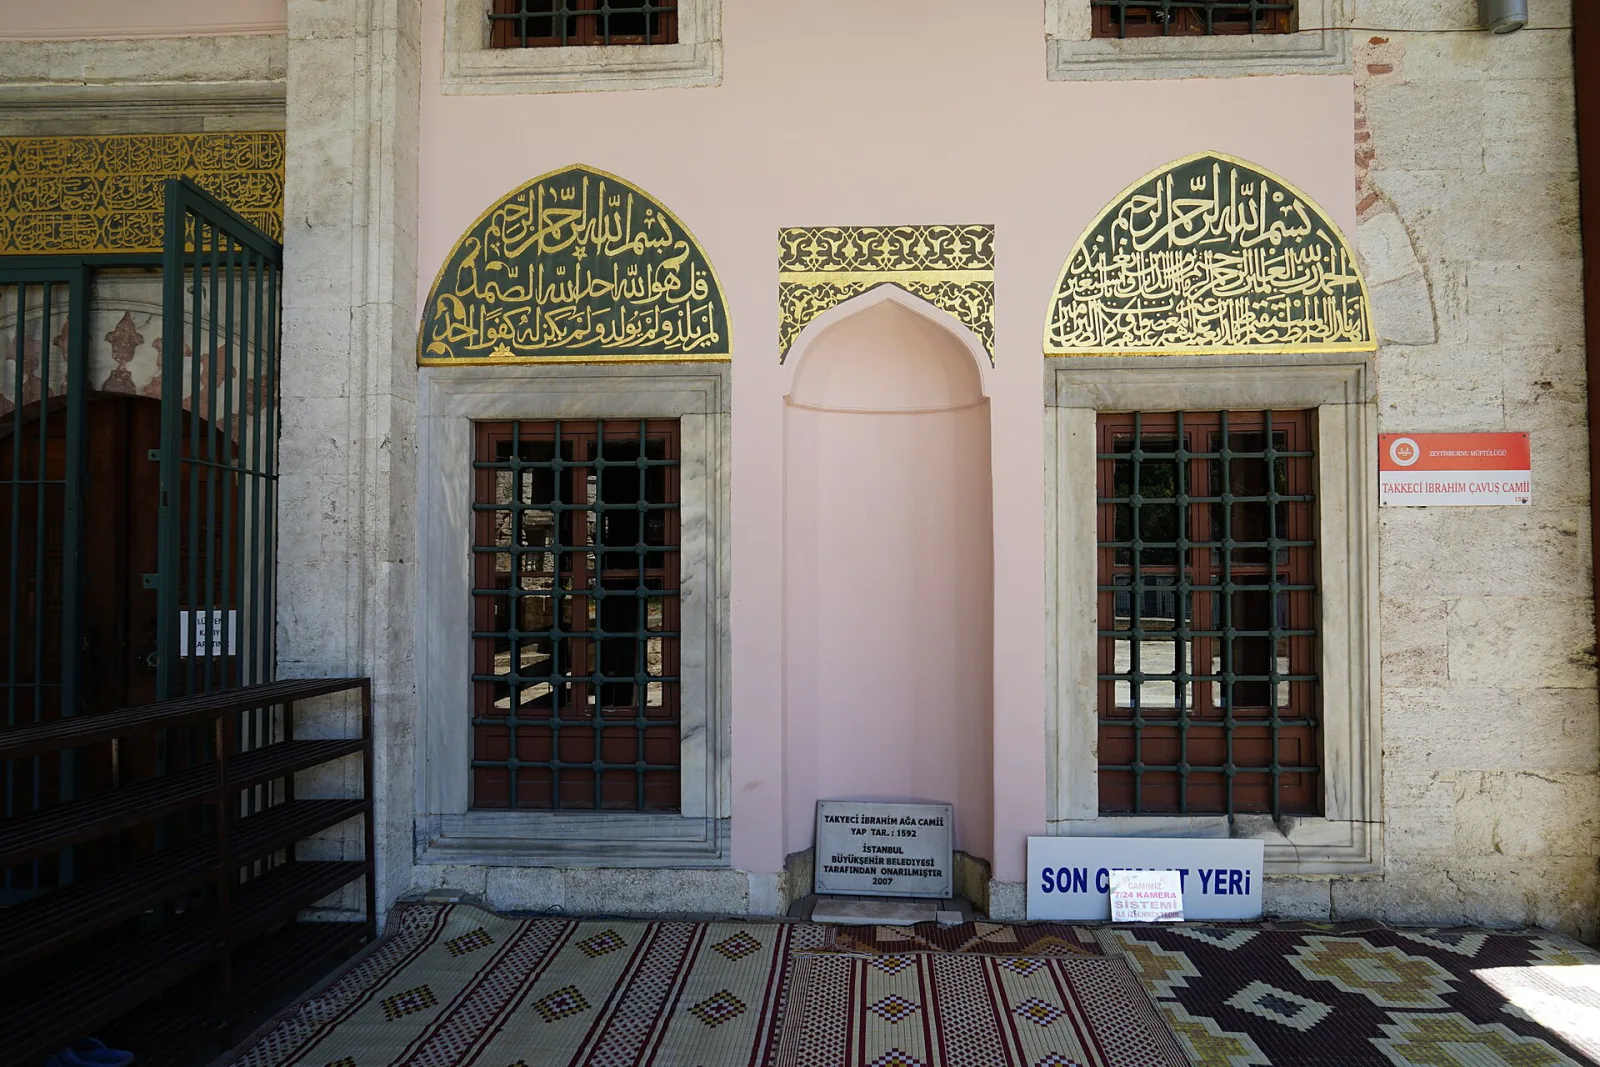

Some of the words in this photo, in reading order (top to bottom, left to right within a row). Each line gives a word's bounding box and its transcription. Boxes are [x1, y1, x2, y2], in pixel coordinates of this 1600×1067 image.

[1382, 481, 1423, 493] TAKKECİ
[1425, 481, 1466, 493] İBRAHİM
[1469, 482, 1500, 495] ÇAVUŞ
[1502, 481, 1530, 493] CAMİİ
[824, 814, 860, 824] TAKYECİ
[861, 814, 898, 826] İBRAHİM
[898, 817, 917, 827] AĞA
[918, 817, 944, 827] CAMİİ
[850, 828, 867, 836] YAP
[897, 830, 917, 838] 1592
[862, 843, 904, 855] İSTANBUL
[831, 853, 885, 866] BÜYÜKŞEHİR
[823, 865, 877, 875] TARAFINDAN
[880, 867, 943, 878] ONARILMIŞTIR
[872, 878, 893, 886] 2007
[1041, 867, 1088, 894] SON
[1114, 891, 1134, 899] 7/24
[1136, 891, 1177, 899] KAMERA
[1114, 899, 1178, 910] SİSTEMİ
